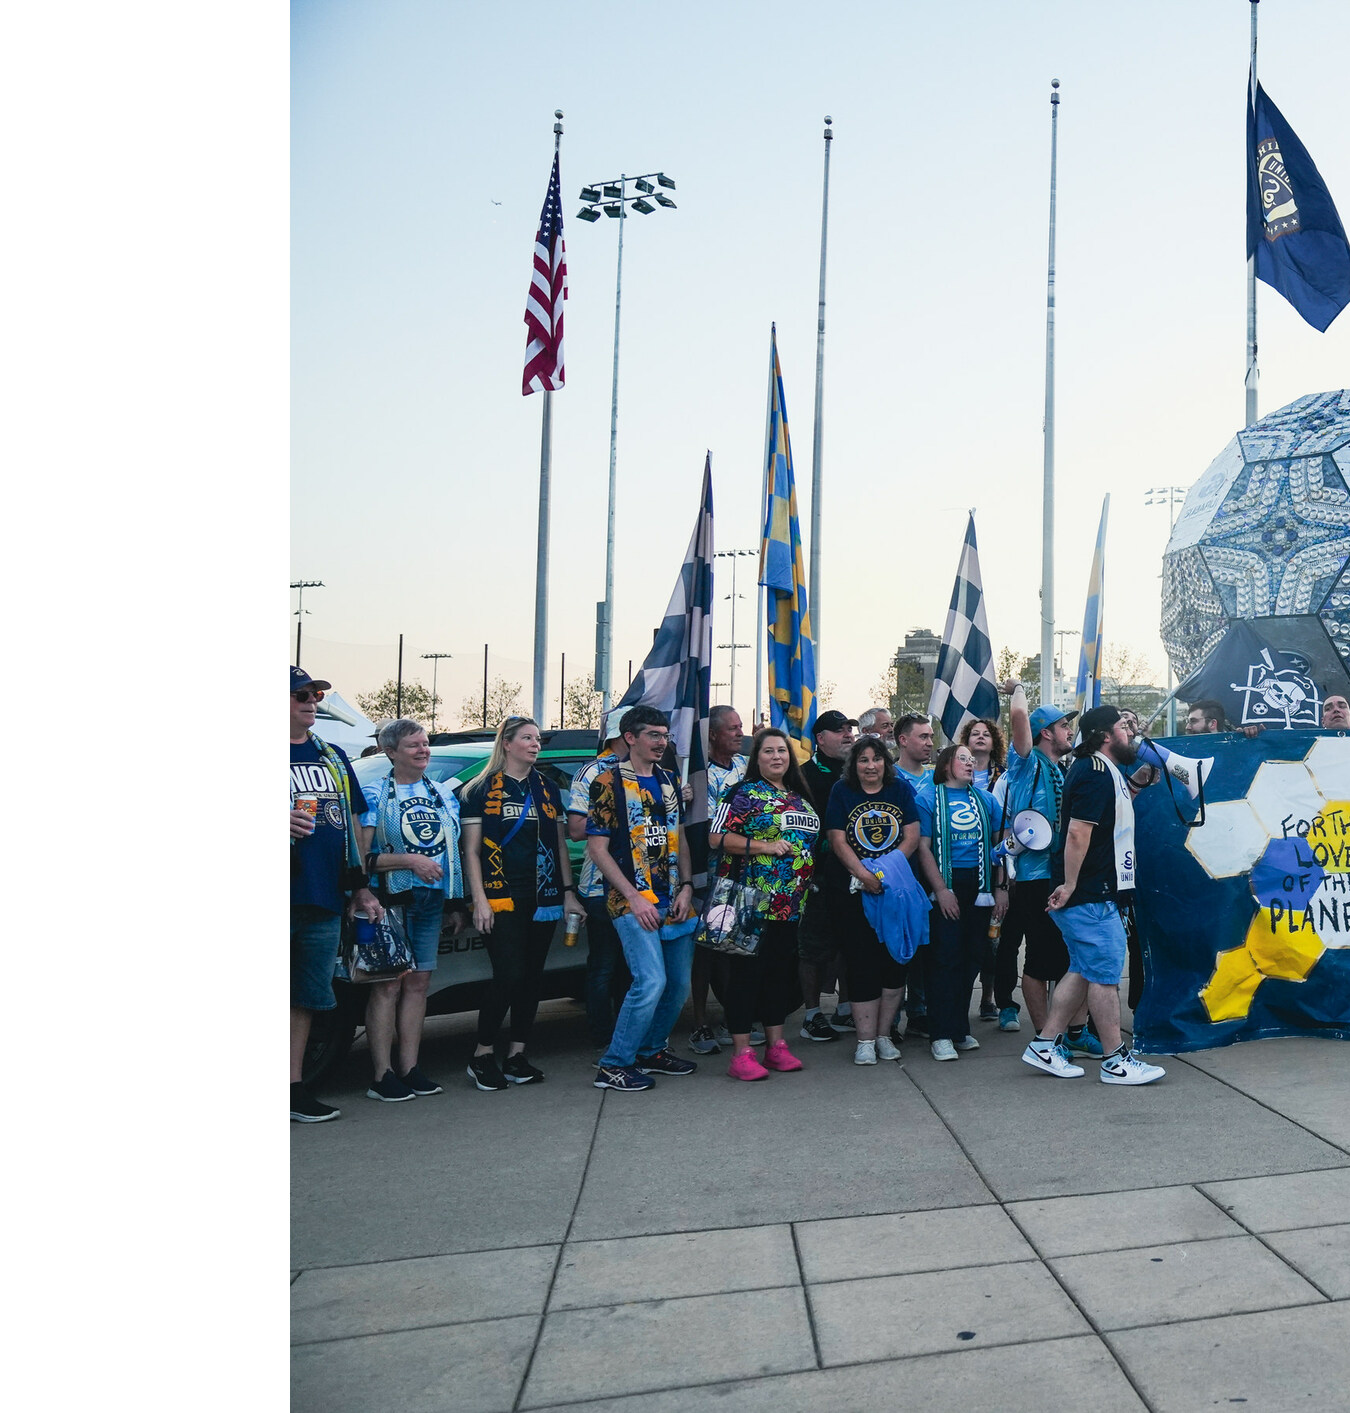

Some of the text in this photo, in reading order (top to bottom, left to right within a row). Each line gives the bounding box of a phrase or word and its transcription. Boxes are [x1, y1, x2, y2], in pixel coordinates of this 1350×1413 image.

[290, 765, 338, 792] NION
[410, 813, 436, 821] UNION
[785, 815, 819, 829] BIMBO
[645, 836, 667, 847] NCER
[1283, 874, 1311, 893] OF
[438, 937, 485, 954] SUB
